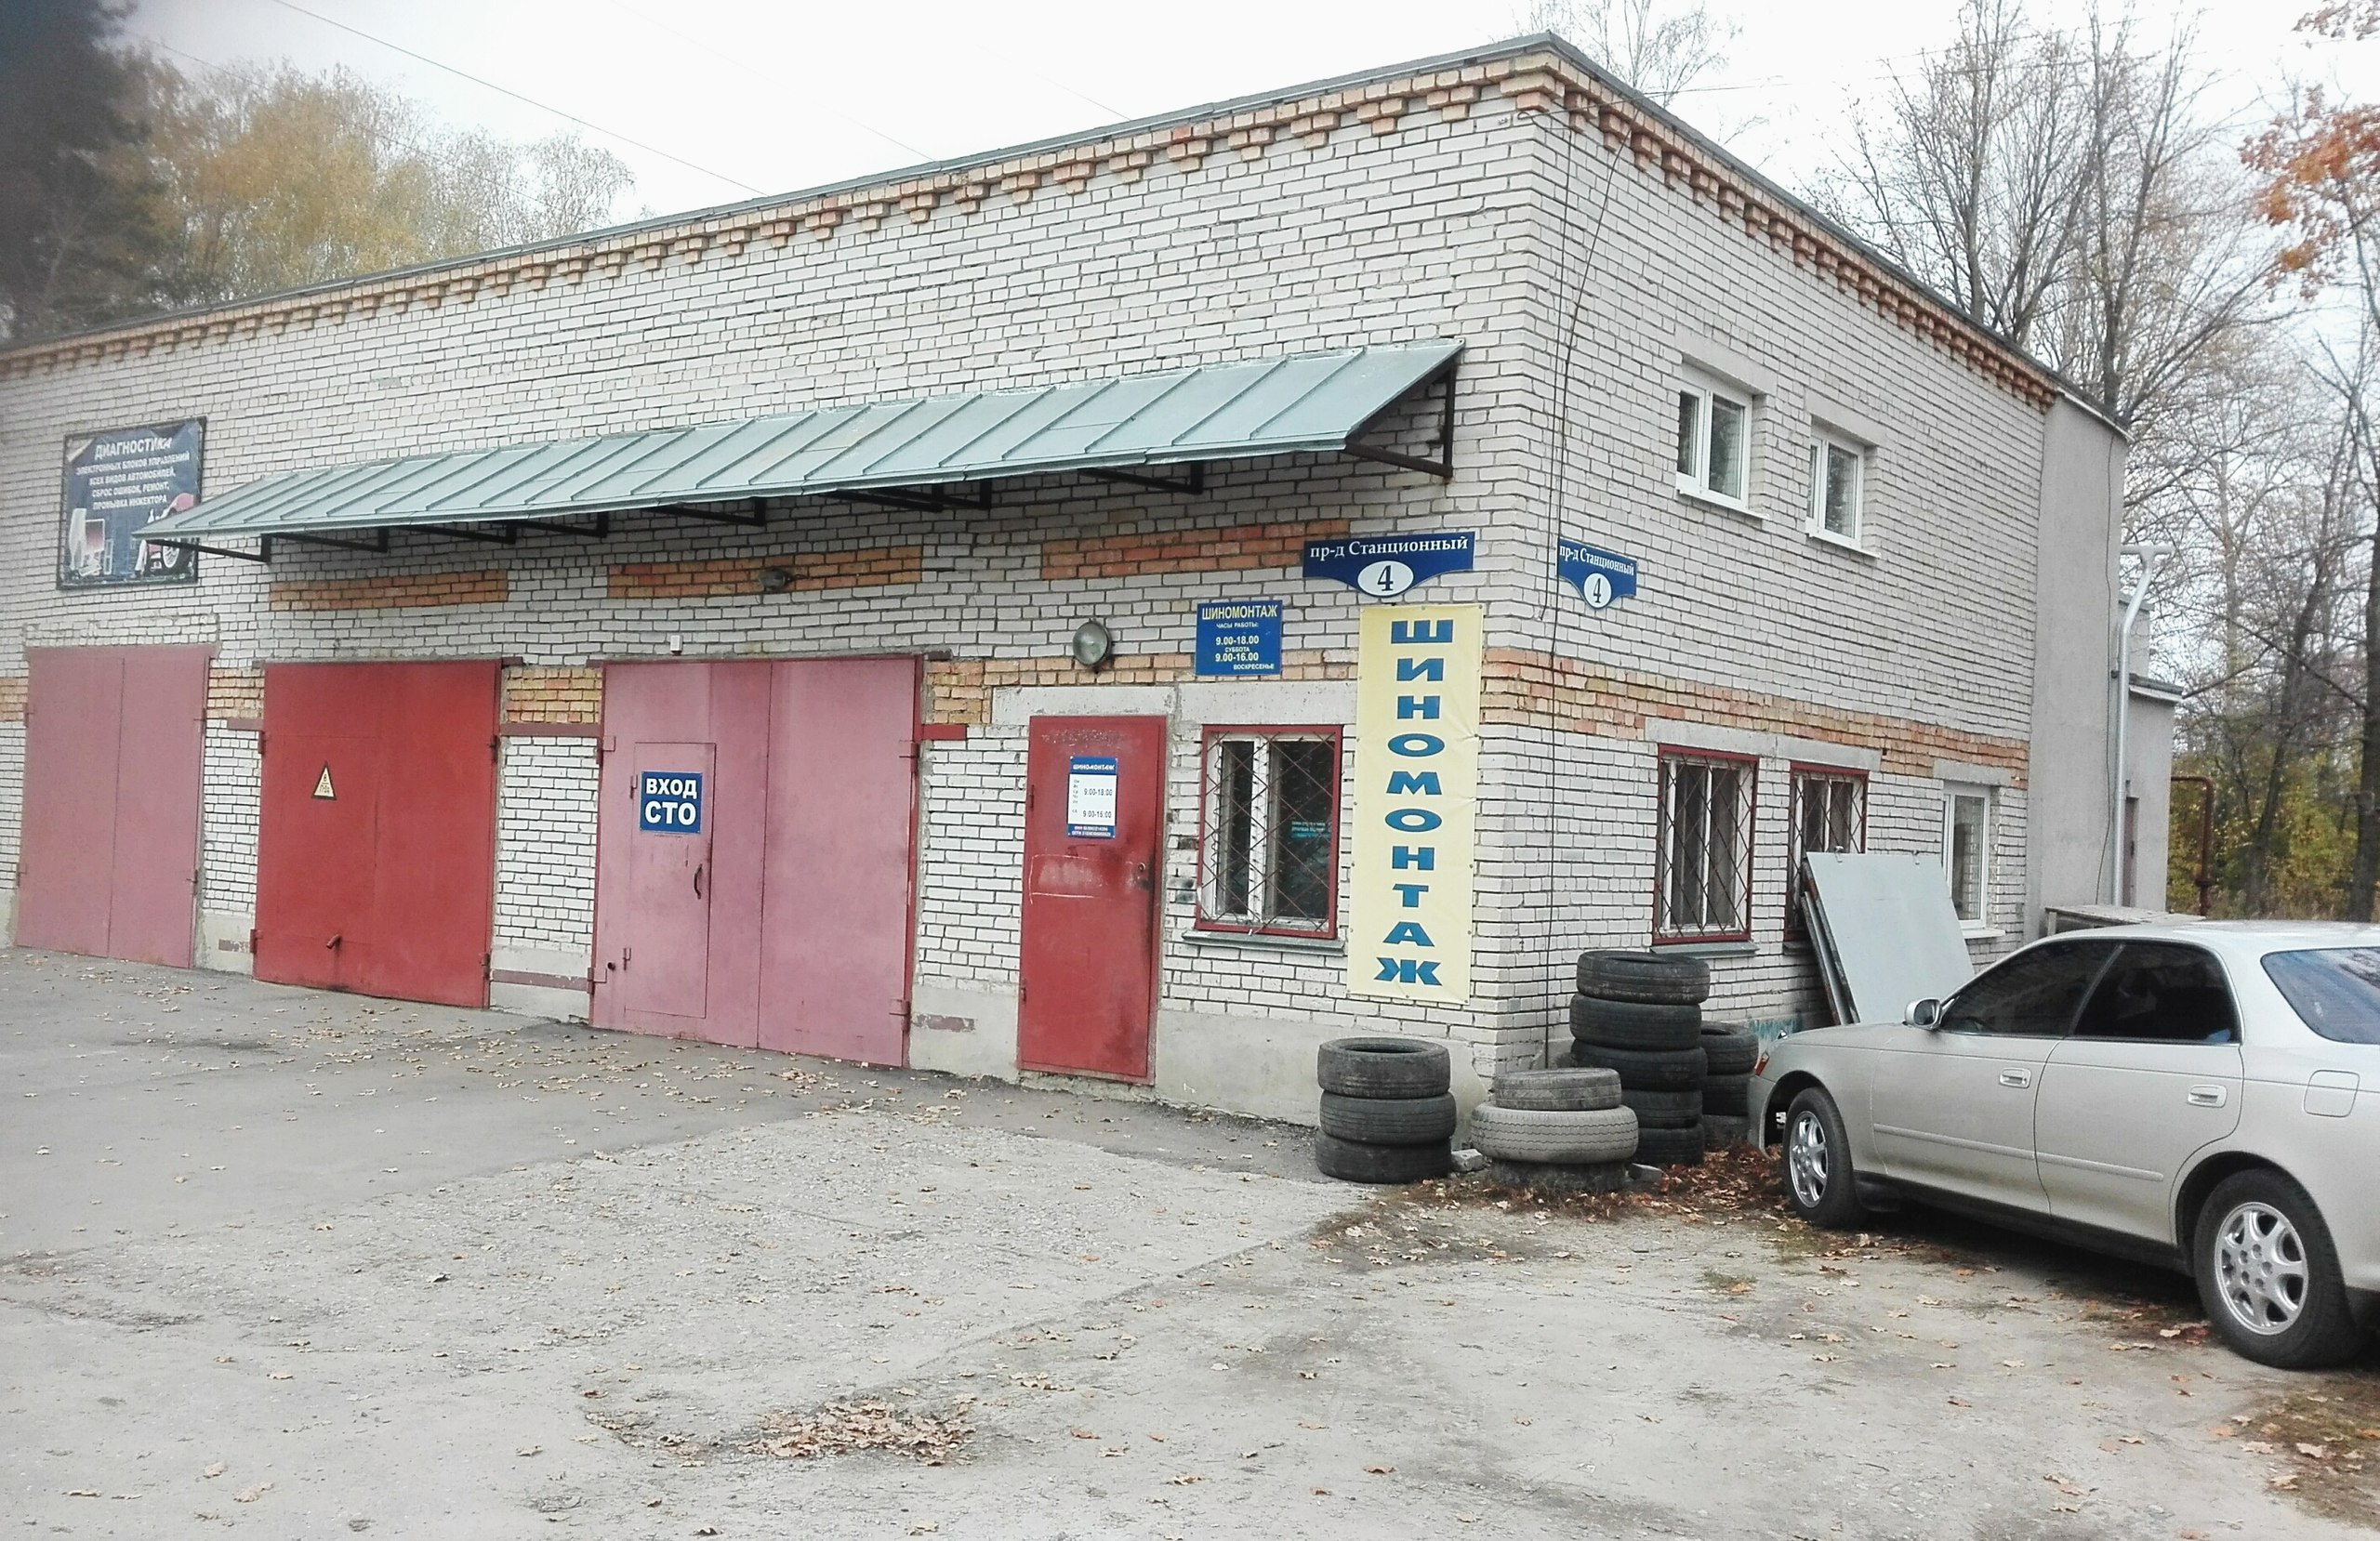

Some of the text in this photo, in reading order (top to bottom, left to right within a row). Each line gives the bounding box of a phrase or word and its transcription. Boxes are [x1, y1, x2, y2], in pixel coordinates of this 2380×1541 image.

[95, 437, 172, 460] ДИАГНОСТИКА
[1310, 536, 1468, 561] пр-д Станционный
[1559, 546, 1634, 575] пр-д Станционный
[1377, 565, 1394, 592] 4
[1593, 577, 1602, 604] 4
[1202, 605, 1278, 620] ШИНОМОНТАЖ
[1215, 635, 1260, 646] 9.00-18.00
[1215, 652, 1259, 663] 9.00-16.00
[646, 778, 697, 799] ВХОД
[644, 800, 696, 825] СТО
[1373, 619, 1454, 986] ШИНОМОНТАЖ
